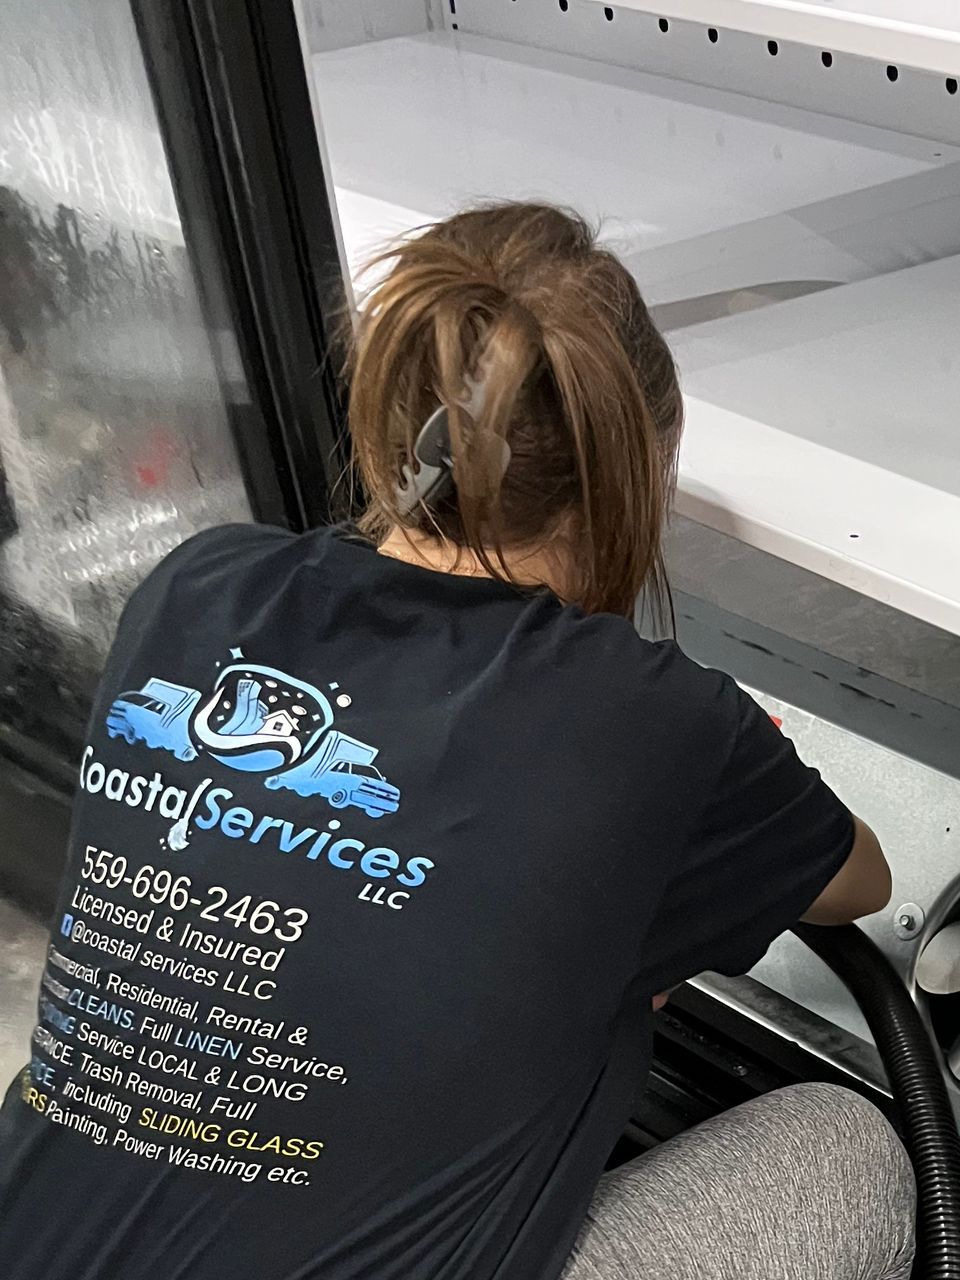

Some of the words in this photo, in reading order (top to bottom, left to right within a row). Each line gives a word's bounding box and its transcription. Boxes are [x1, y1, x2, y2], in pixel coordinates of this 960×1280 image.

[195, 787, 434, 888] Services
[71, 885, 156, 935] Licensed
[156, 916, 174, 943] &
[179, 923, 286, 972] Insured
[81, 845, 309, 943] 559-696-2463
[357, 883, 410, 911] LLC
[70, 919, 142, 962] @coastal
[140, 950, 219, 986] services
[223, 970, 277, 1000] LLC
[67, 988, 136, 1031] CLEANS.
[139, 1016, 174, 1042] Full
[174, 1023, 243, 1060] LINEN
[247, 1046, 349, 1084] Service,
[106, 973, 199, 1024] Residential,
[206, 1006, 285, 1040] Rental
[288, 1026, 309, 1046] &
[77, 1022, 135, 1060] Service
[138, 1045, 199, 1081] LOCAL
[204, 1066, 222, 1086] &
[226, 1070, 309, 1101] LONG
[80, 1052, 123, 1087] Trash
[125, 1072, 202, 1113] Removal,
[210, 1096, 257, 1121] Full
[45, 1100, 109, 1145] Painting,
[112, 1129, 163, 1161] Power
[168, 1147, 263, 1183] Washing
[267, 1166, 311, 1186] etc.
[63, 1076, 132, 1124] including
[138, 1107, 222, 1143] SLIDING
[227, 1129, 324, 1160] GLASS
